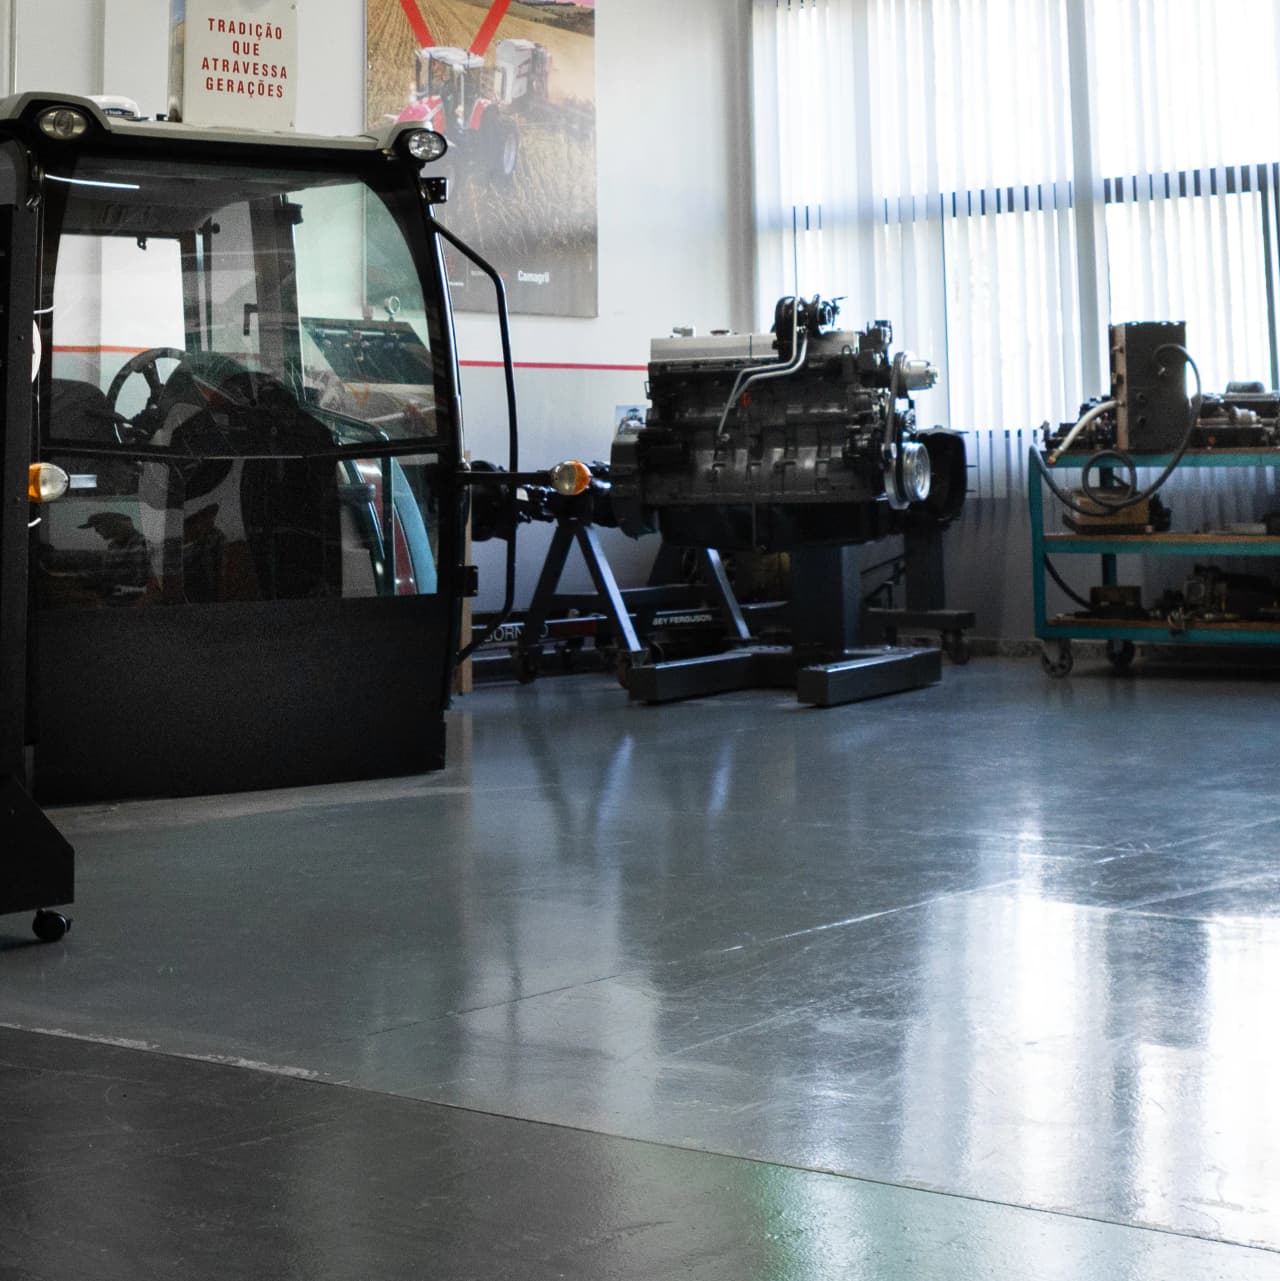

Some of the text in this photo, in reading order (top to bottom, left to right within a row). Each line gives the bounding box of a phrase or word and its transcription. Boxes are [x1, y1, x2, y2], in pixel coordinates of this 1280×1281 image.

[208, 18, 282, 40] TRADIÇÃO
[232, 40, 260, 56] QUE
[201, 57, 287, 79] ATRAVESSA
[205, 77, 283, 98] GERAÇÕES
